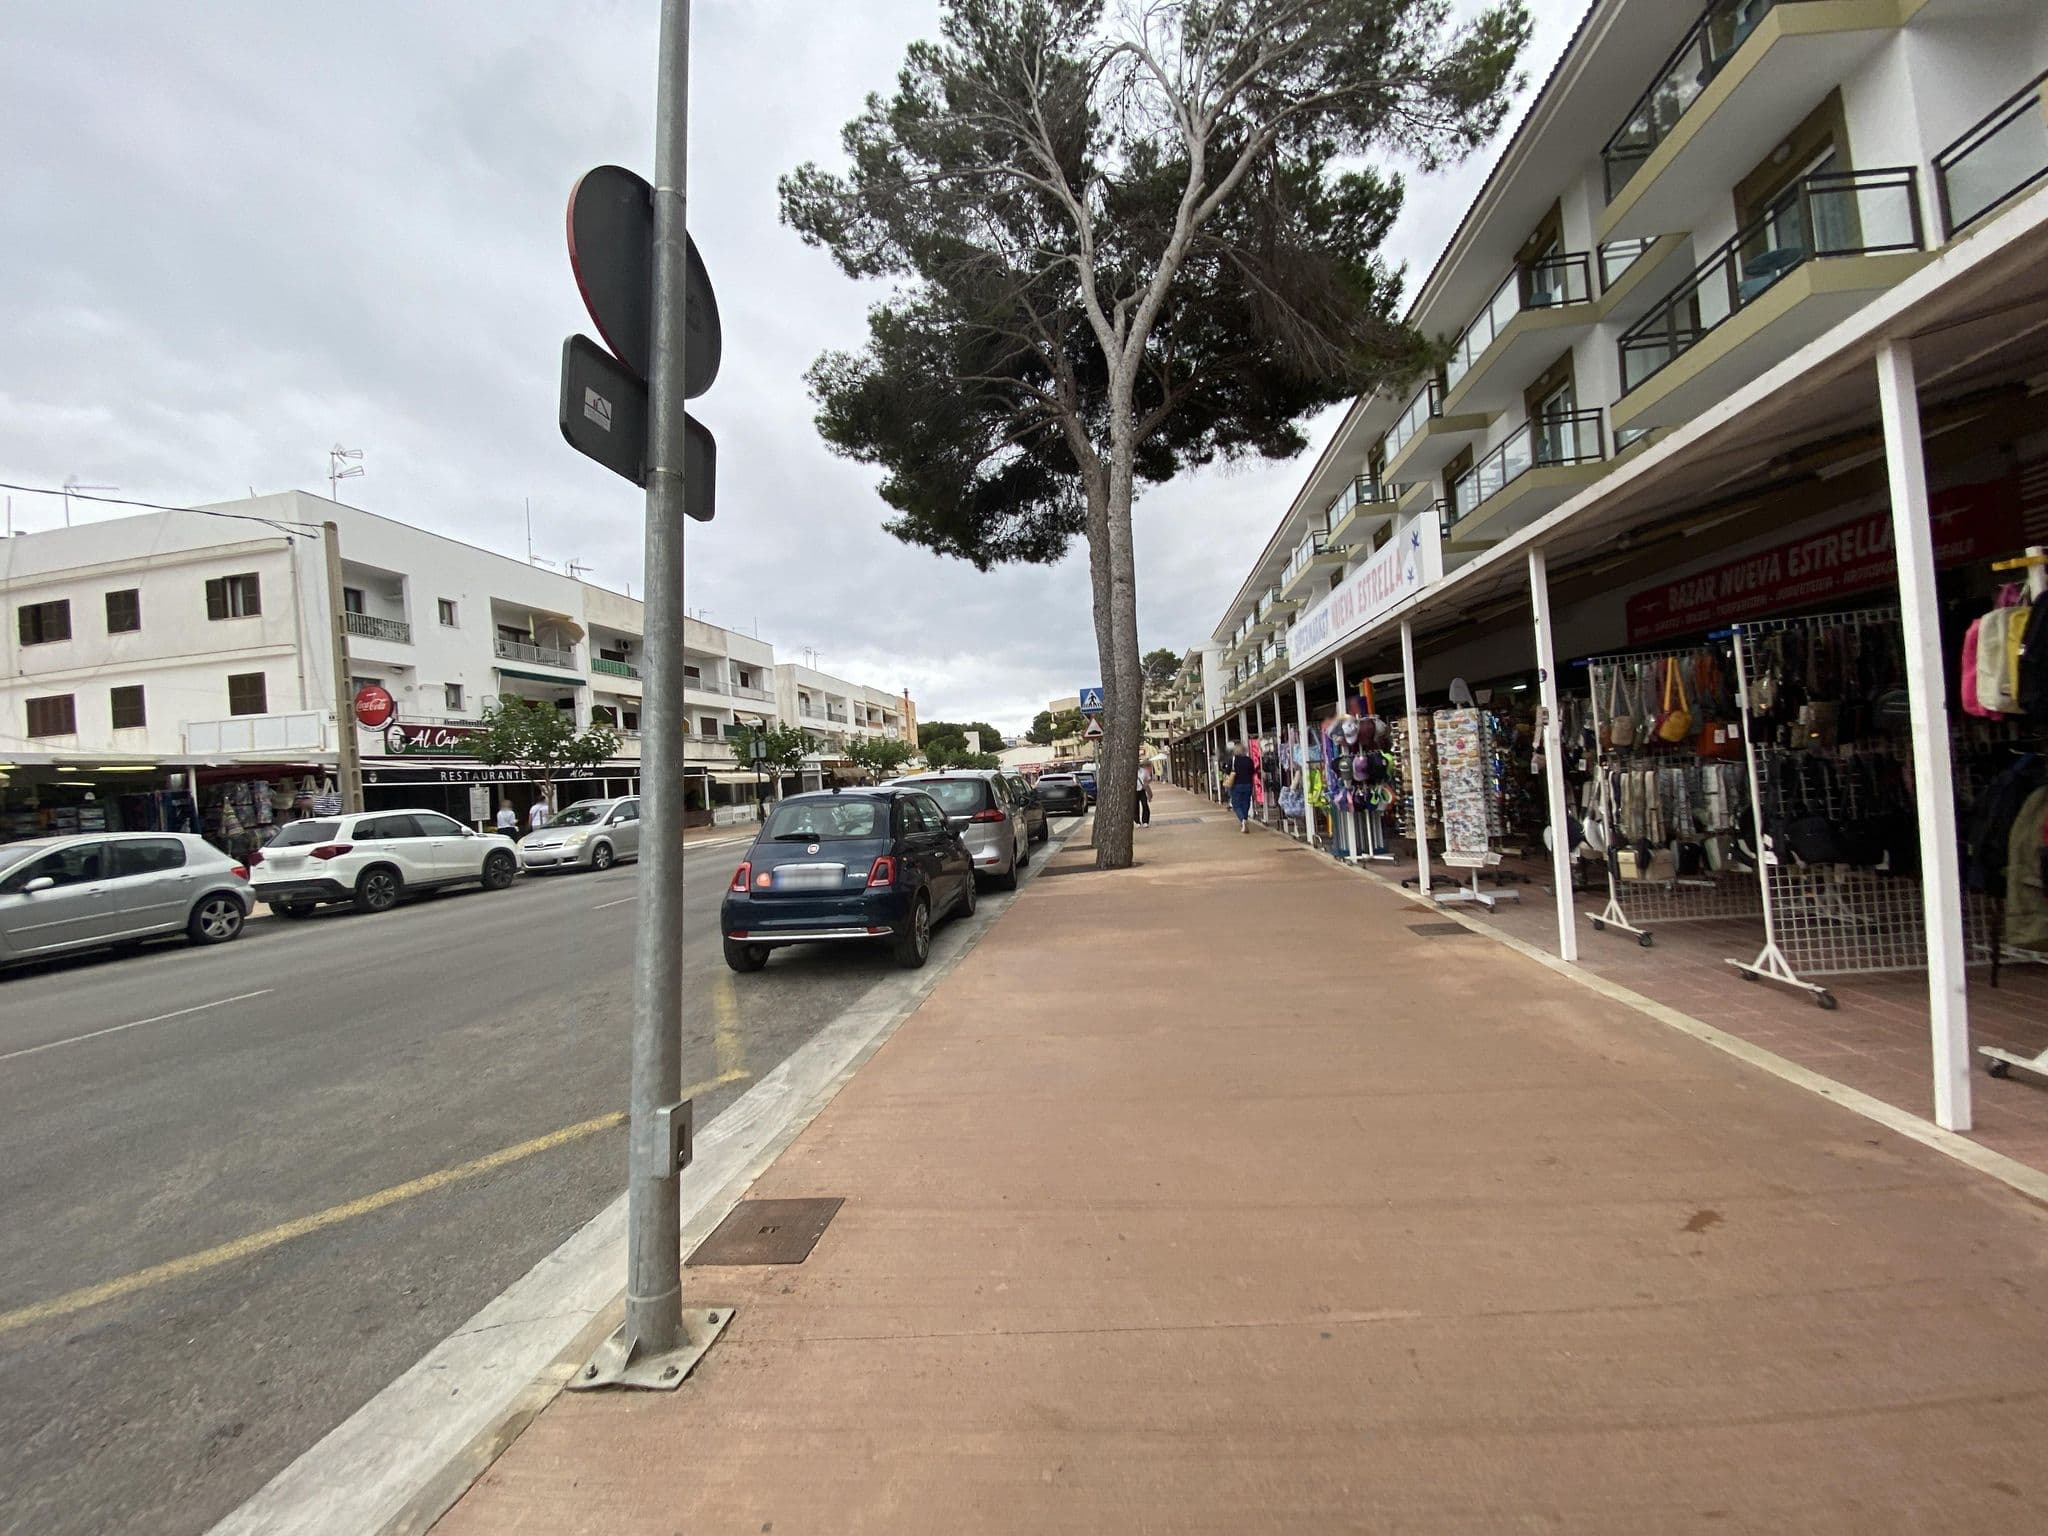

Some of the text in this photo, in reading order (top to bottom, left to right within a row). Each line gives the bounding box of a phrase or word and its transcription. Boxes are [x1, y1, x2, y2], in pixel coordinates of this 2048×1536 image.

[1357, 548, 1404, 614] ESTRELLA
[1667, 574, 1716, 612] BAZAR
[1721, 555, 1783, 597] NUEVA
[440, 770, 527, 781] RESTAURANTE
